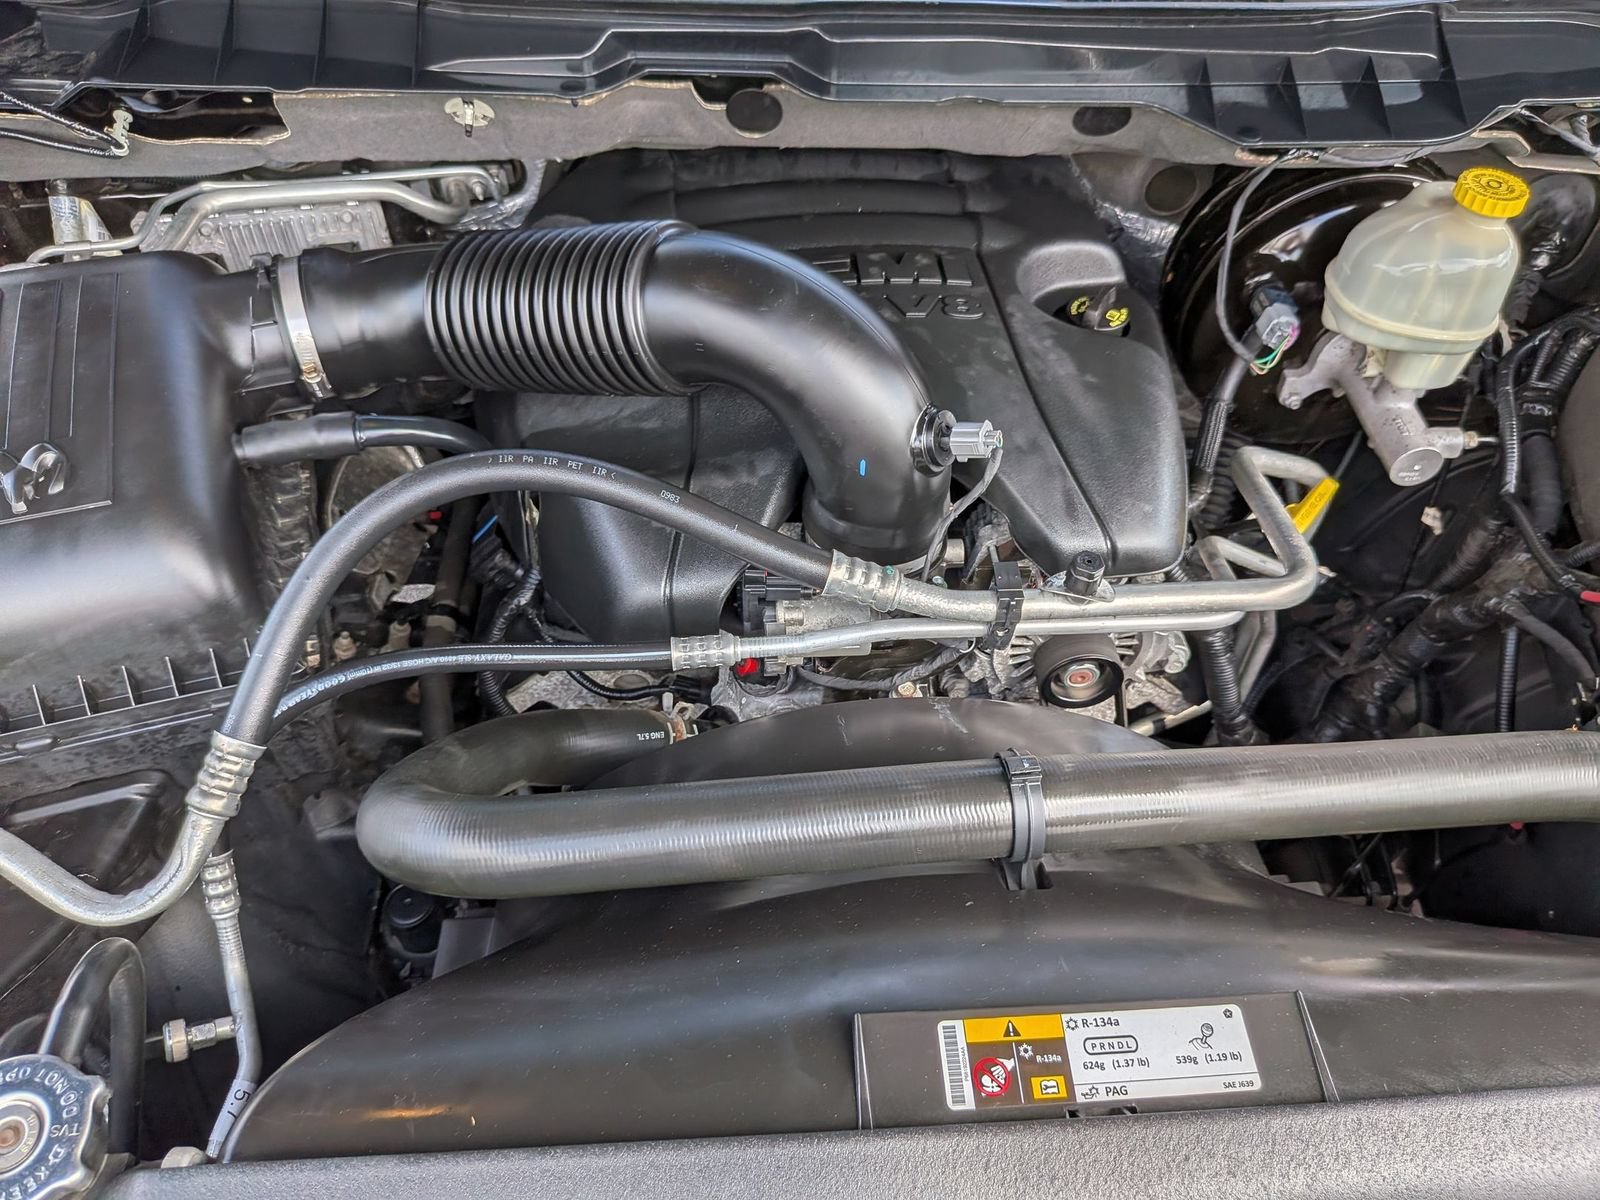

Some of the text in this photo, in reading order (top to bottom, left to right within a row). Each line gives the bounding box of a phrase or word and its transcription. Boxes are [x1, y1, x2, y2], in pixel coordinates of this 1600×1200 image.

[812, 252, 974, 287] EMI
[881, 294, 986, 320] V8
[498, 454, 515, 464] IIR
[522, 455, 535, 464] PA
[543, 456, 559, 467] IIR
[567, 460, 584, 471] PET
[592, 466, 608, 478] IIR
[660, 490, 681, 504] 0983
[402, 658, 424, 667] HOSE
[474, 652, 513, 663] GALAXY
[636, 731, 664, 741] ENG 5.7L
[1081, 1017, 1121, 1029] R-134a
[1035, 1053, 1063, 1064] R-134a
[1082, 1056, 1151, 1072] 624g (1.37 lb)
[1175, 1050, 1243, 1066] 539g (1.19 lb)
[33, 1068, 70, 1096] NOT
[1222, 1079, 1255, 1090] SAE J639
[1105, 1085, 1129, 1098] PAG
[50, 1122, 82, 1139] TVS
